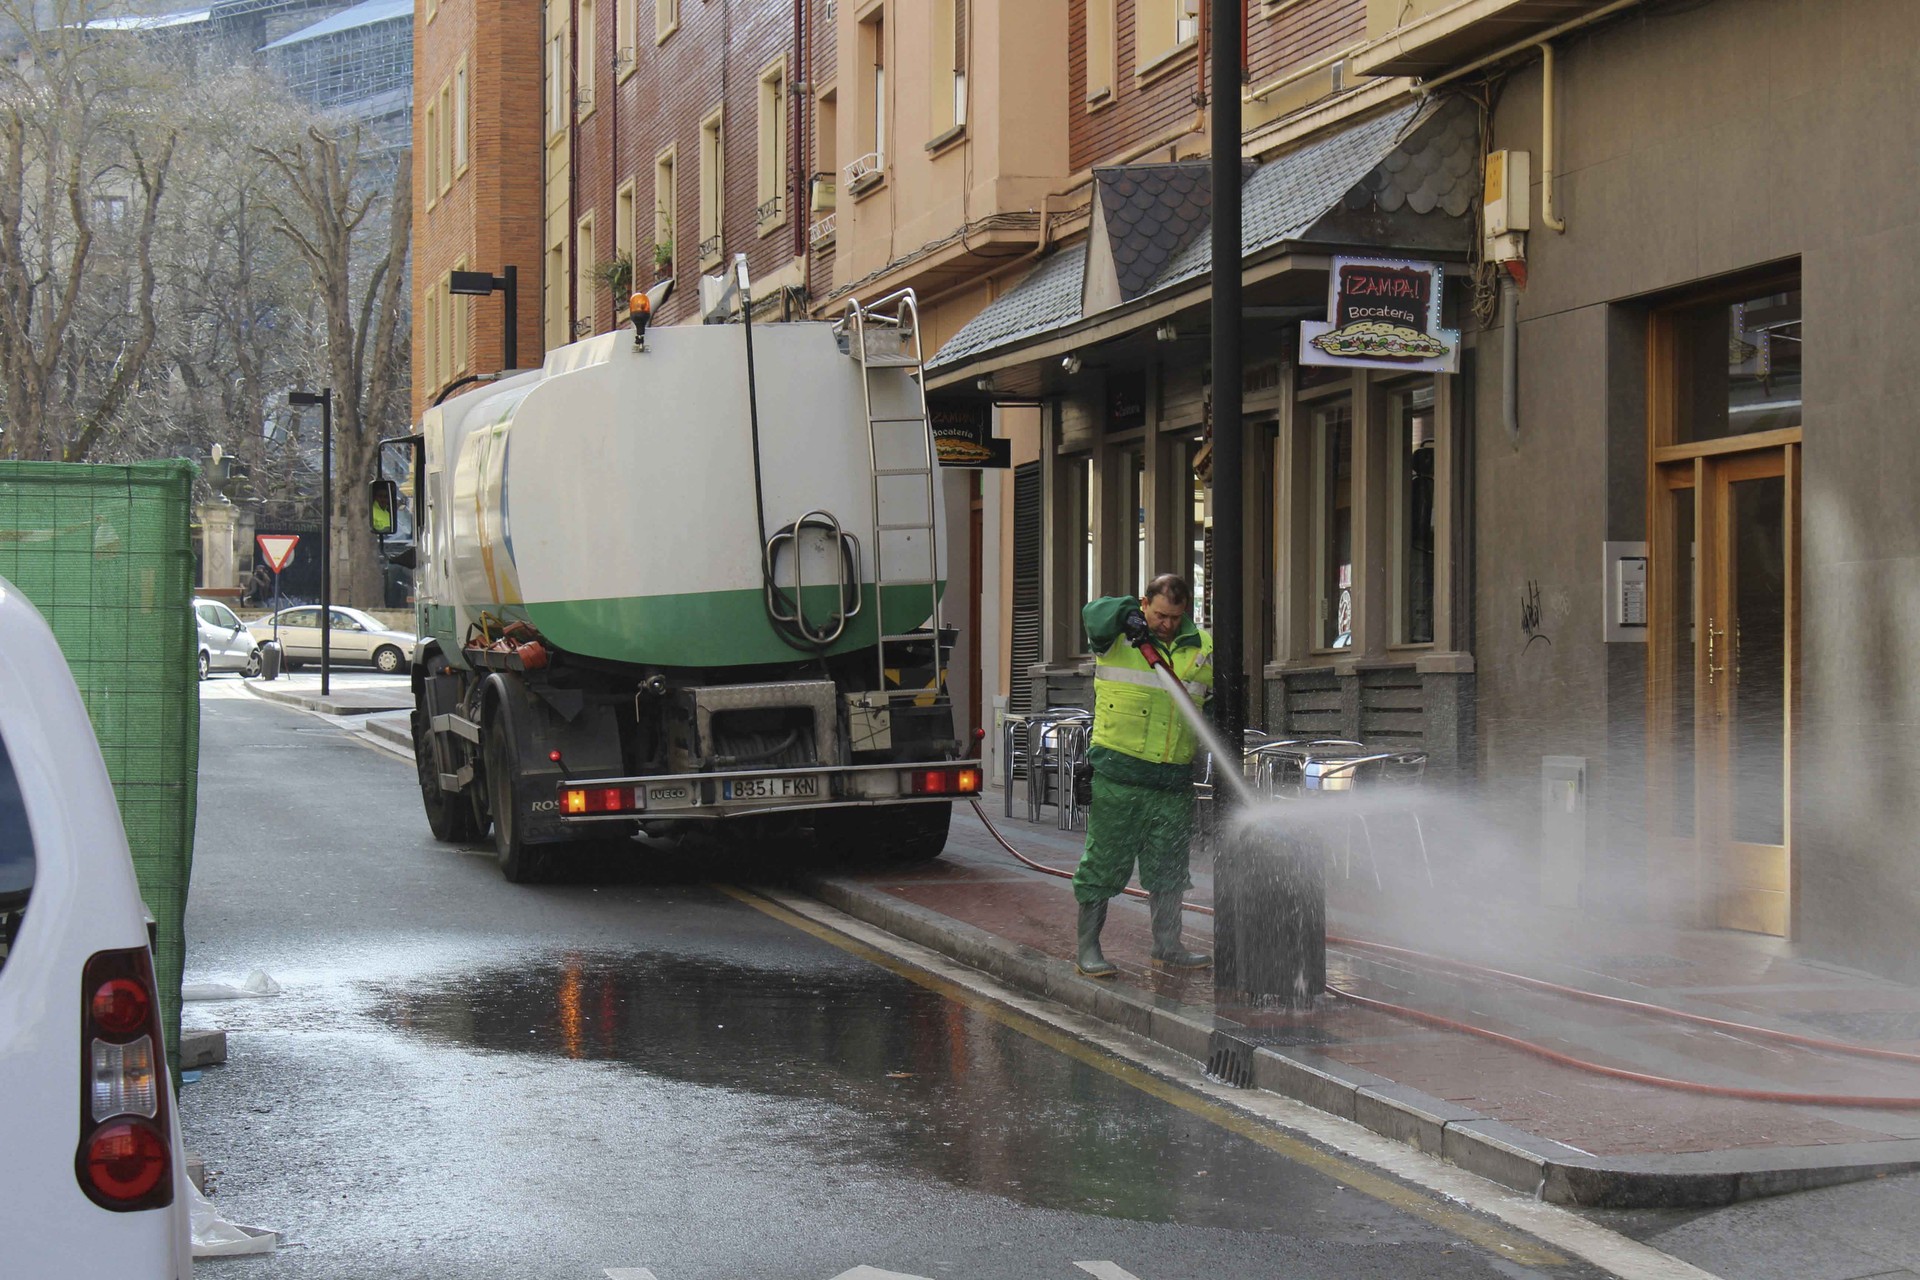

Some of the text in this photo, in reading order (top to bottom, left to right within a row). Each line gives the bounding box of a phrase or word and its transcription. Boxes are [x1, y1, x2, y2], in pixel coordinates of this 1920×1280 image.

[1346, 275, 1420, 299] ¡ZAMPA!
[650, 787, 687, 800] IVECO
[733, 778, 815, 797] 8351 FKN
